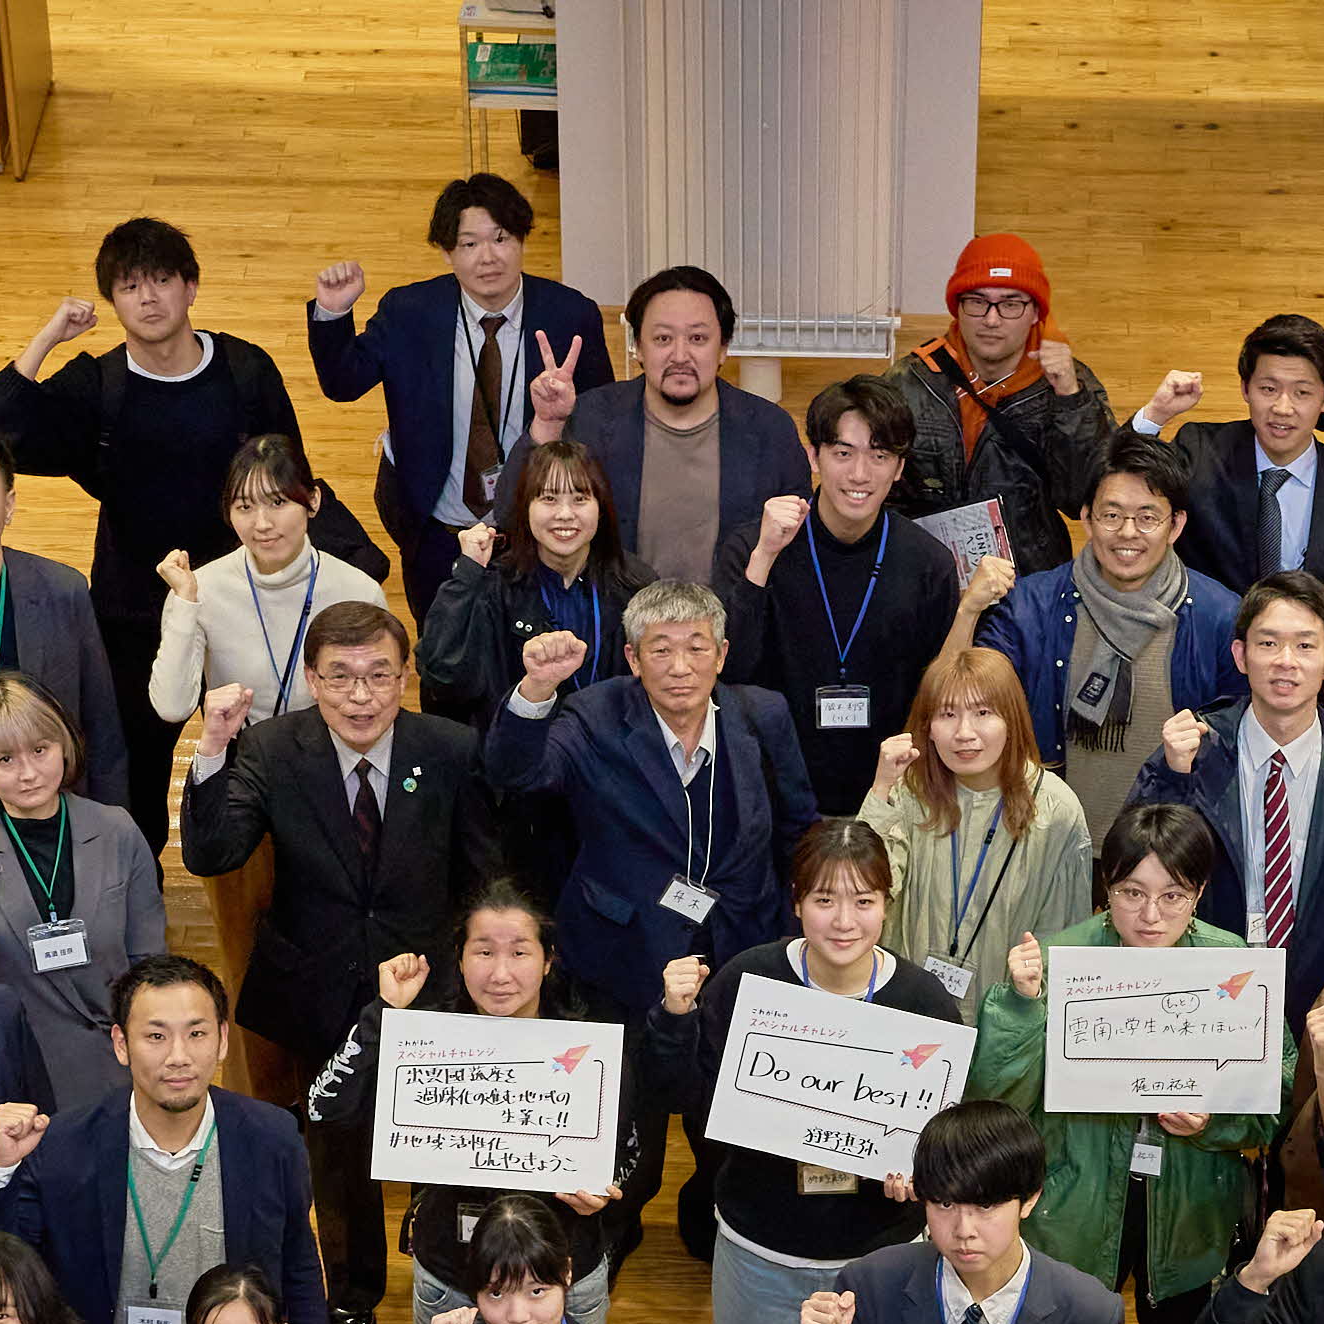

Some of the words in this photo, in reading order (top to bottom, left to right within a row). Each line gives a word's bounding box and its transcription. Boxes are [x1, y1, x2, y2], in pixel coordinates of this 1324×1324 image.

[1065, 978, 1163, 997] スペシャルチャレンジ
[749, 1018, 849, 1039] スペシャルチャレンジ
[397, 1047, 497, 1061] スペシャルチャレンジ
[749, 1051, 790, 1081] Do
[800, 1074, 845, 1093] our
[854, 1073, 911, 1109] best
